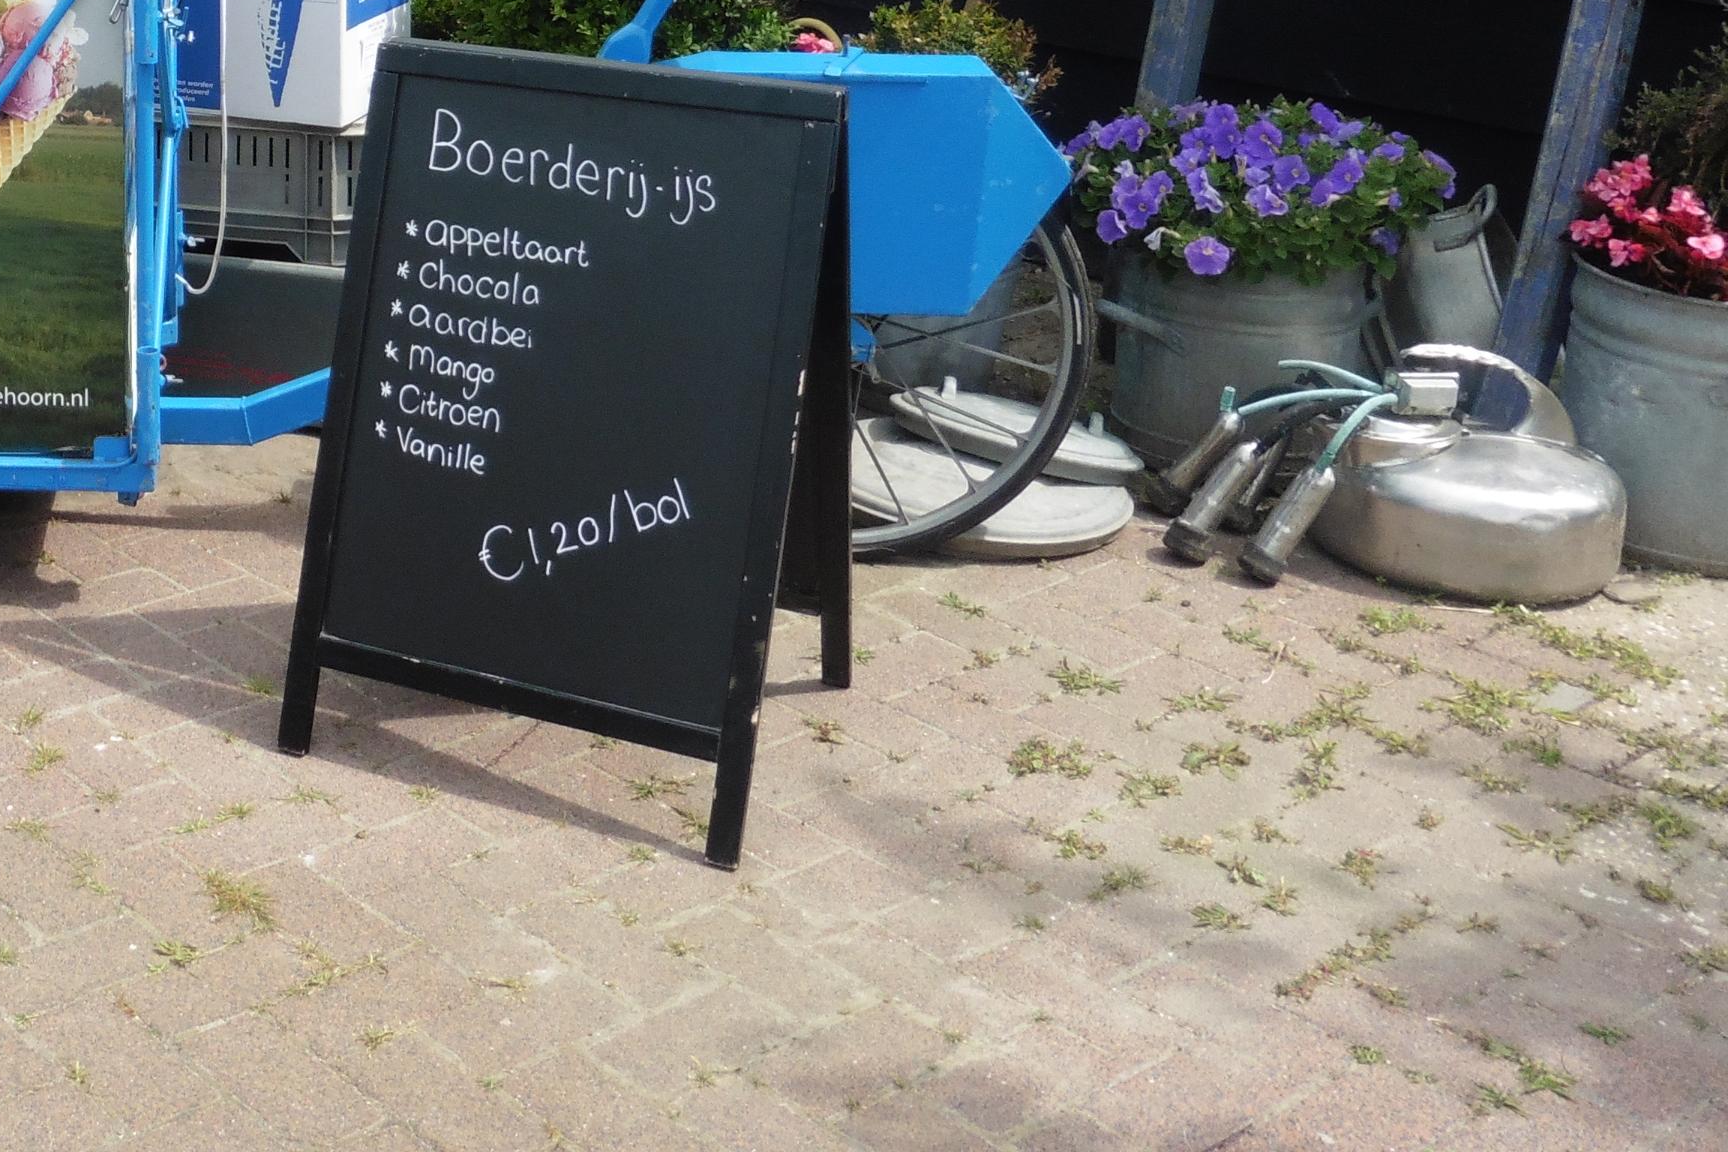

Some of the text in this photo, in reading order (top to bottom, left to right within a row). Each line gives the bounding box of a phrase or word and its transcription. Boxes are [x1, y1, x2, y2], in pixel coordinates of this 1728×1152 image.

[428, 108, 717, 226] Boerderij-ijs
[425, 219, 590, 268] appeltaart
[409, 303, 533, 349] aardbei
[398, 384, 502, 433] Citroen
[397, 425, 486, 476] Vanille
